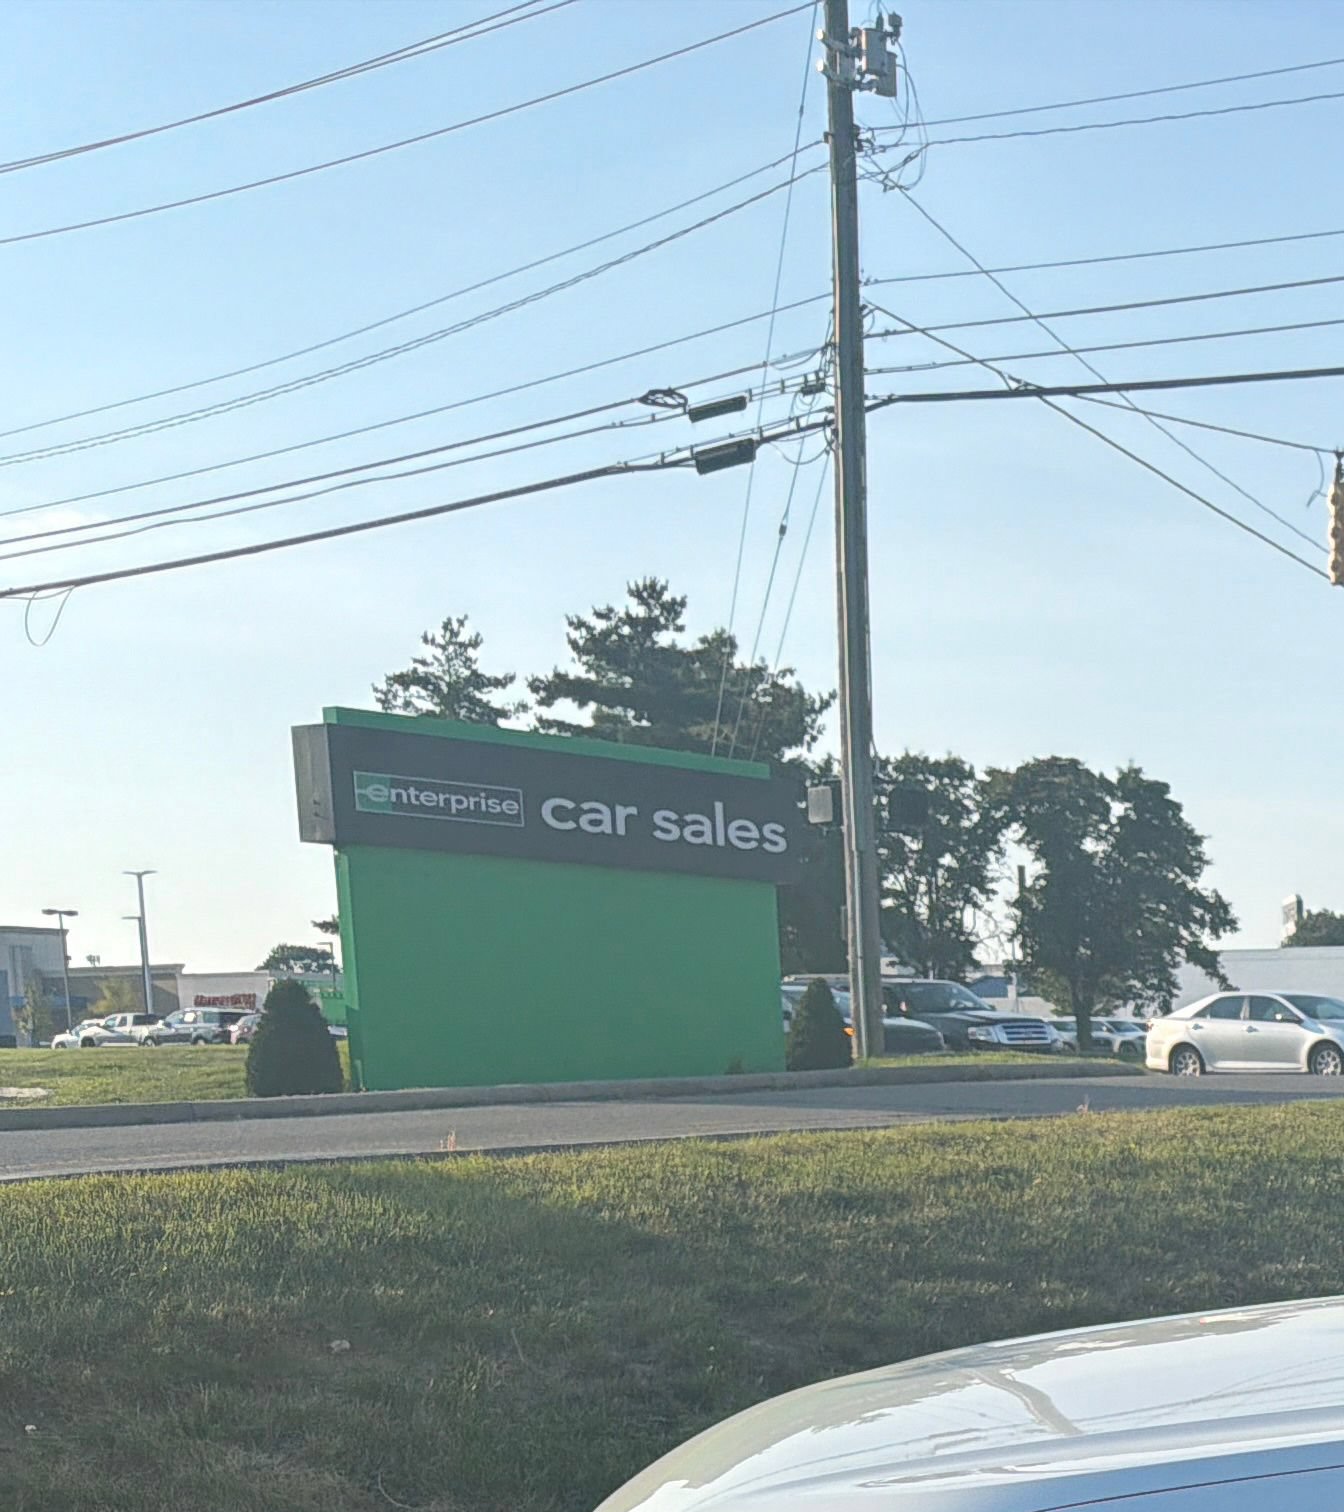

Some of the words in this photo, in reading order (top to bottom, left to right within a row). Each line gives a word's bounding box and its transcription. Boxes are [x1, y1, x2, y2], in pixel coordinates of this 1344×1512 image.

[365, 783, 519, 815] enterprise
[541, 797, 639, 836] car
[652, 801, 788, 853] sales
